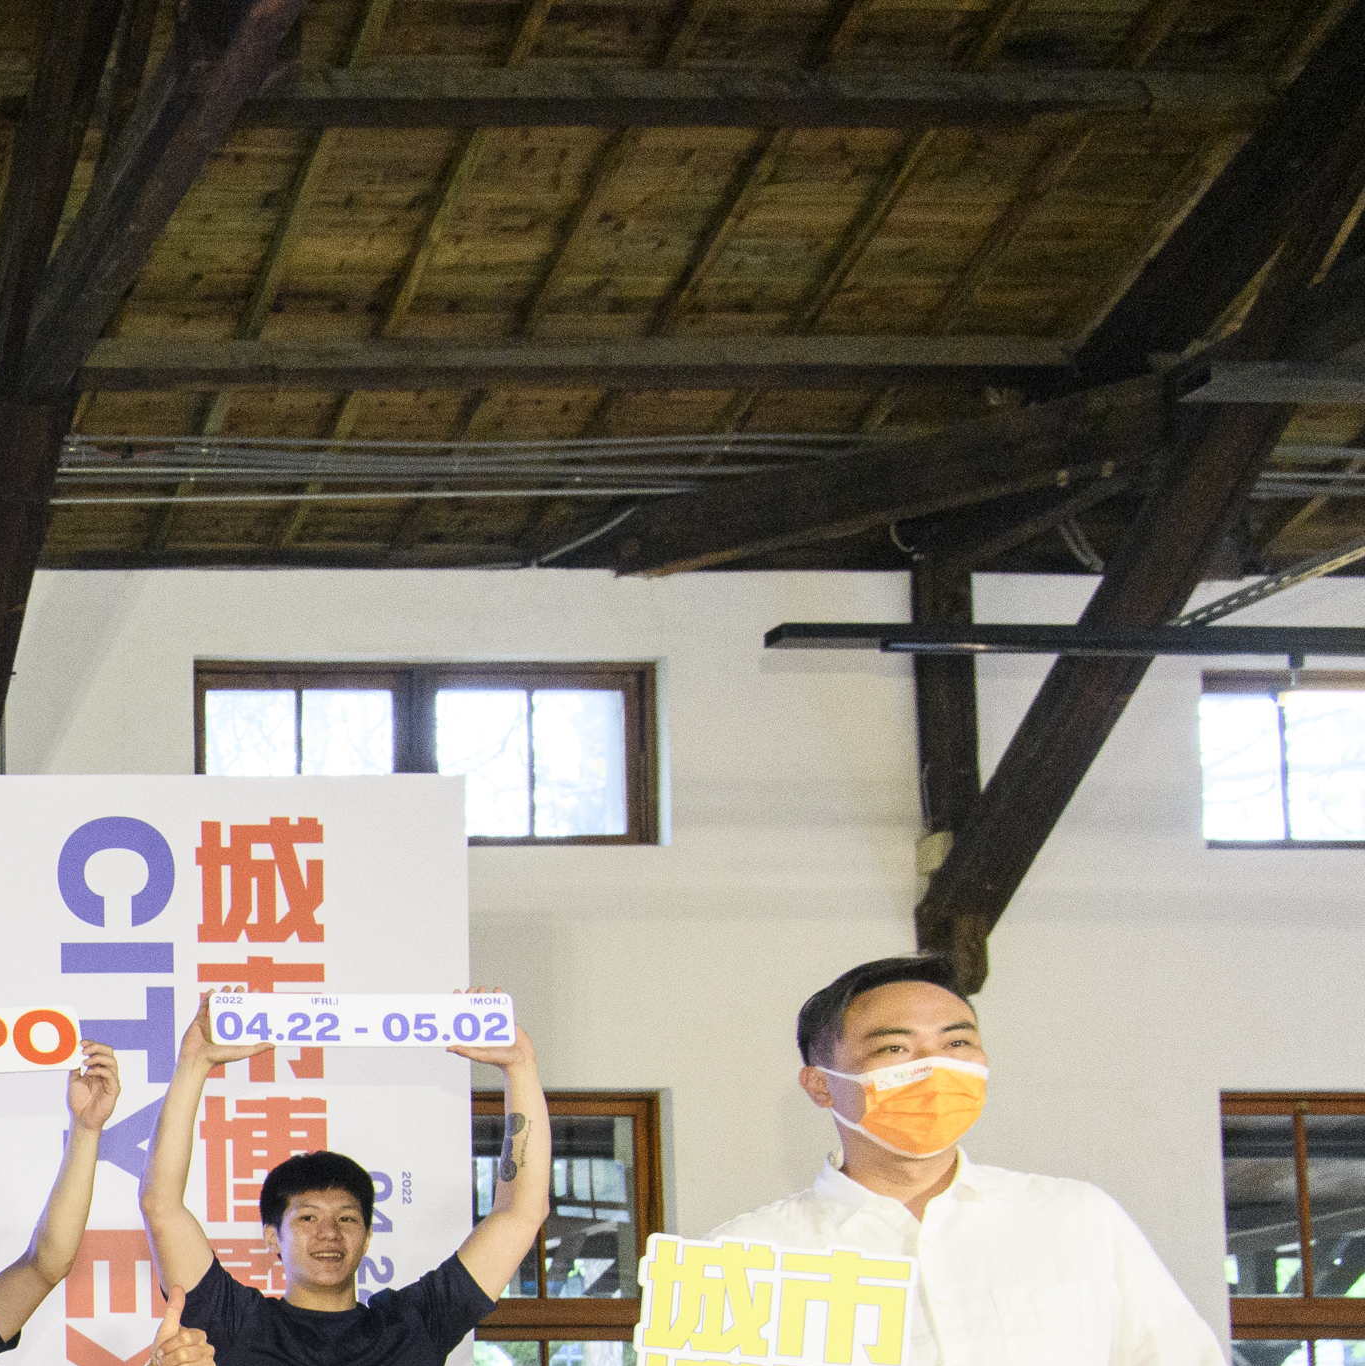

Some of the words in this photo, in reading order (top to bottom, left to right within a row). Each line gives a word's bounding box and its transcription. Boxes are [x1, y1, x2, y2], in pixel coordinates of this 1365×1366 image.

[215, 996, 243, 1005] 2022
[311, 997, 339, 1006] (FRI.)
[470, 997, 508, 1006] (MON.)
[215, 1011, 341, 1041] 04.22
[382, 1012, 510, 1042] 05.02
[402, 1171, 412, 1205] 2022
[643, 1239, 913, 1366] 城市
